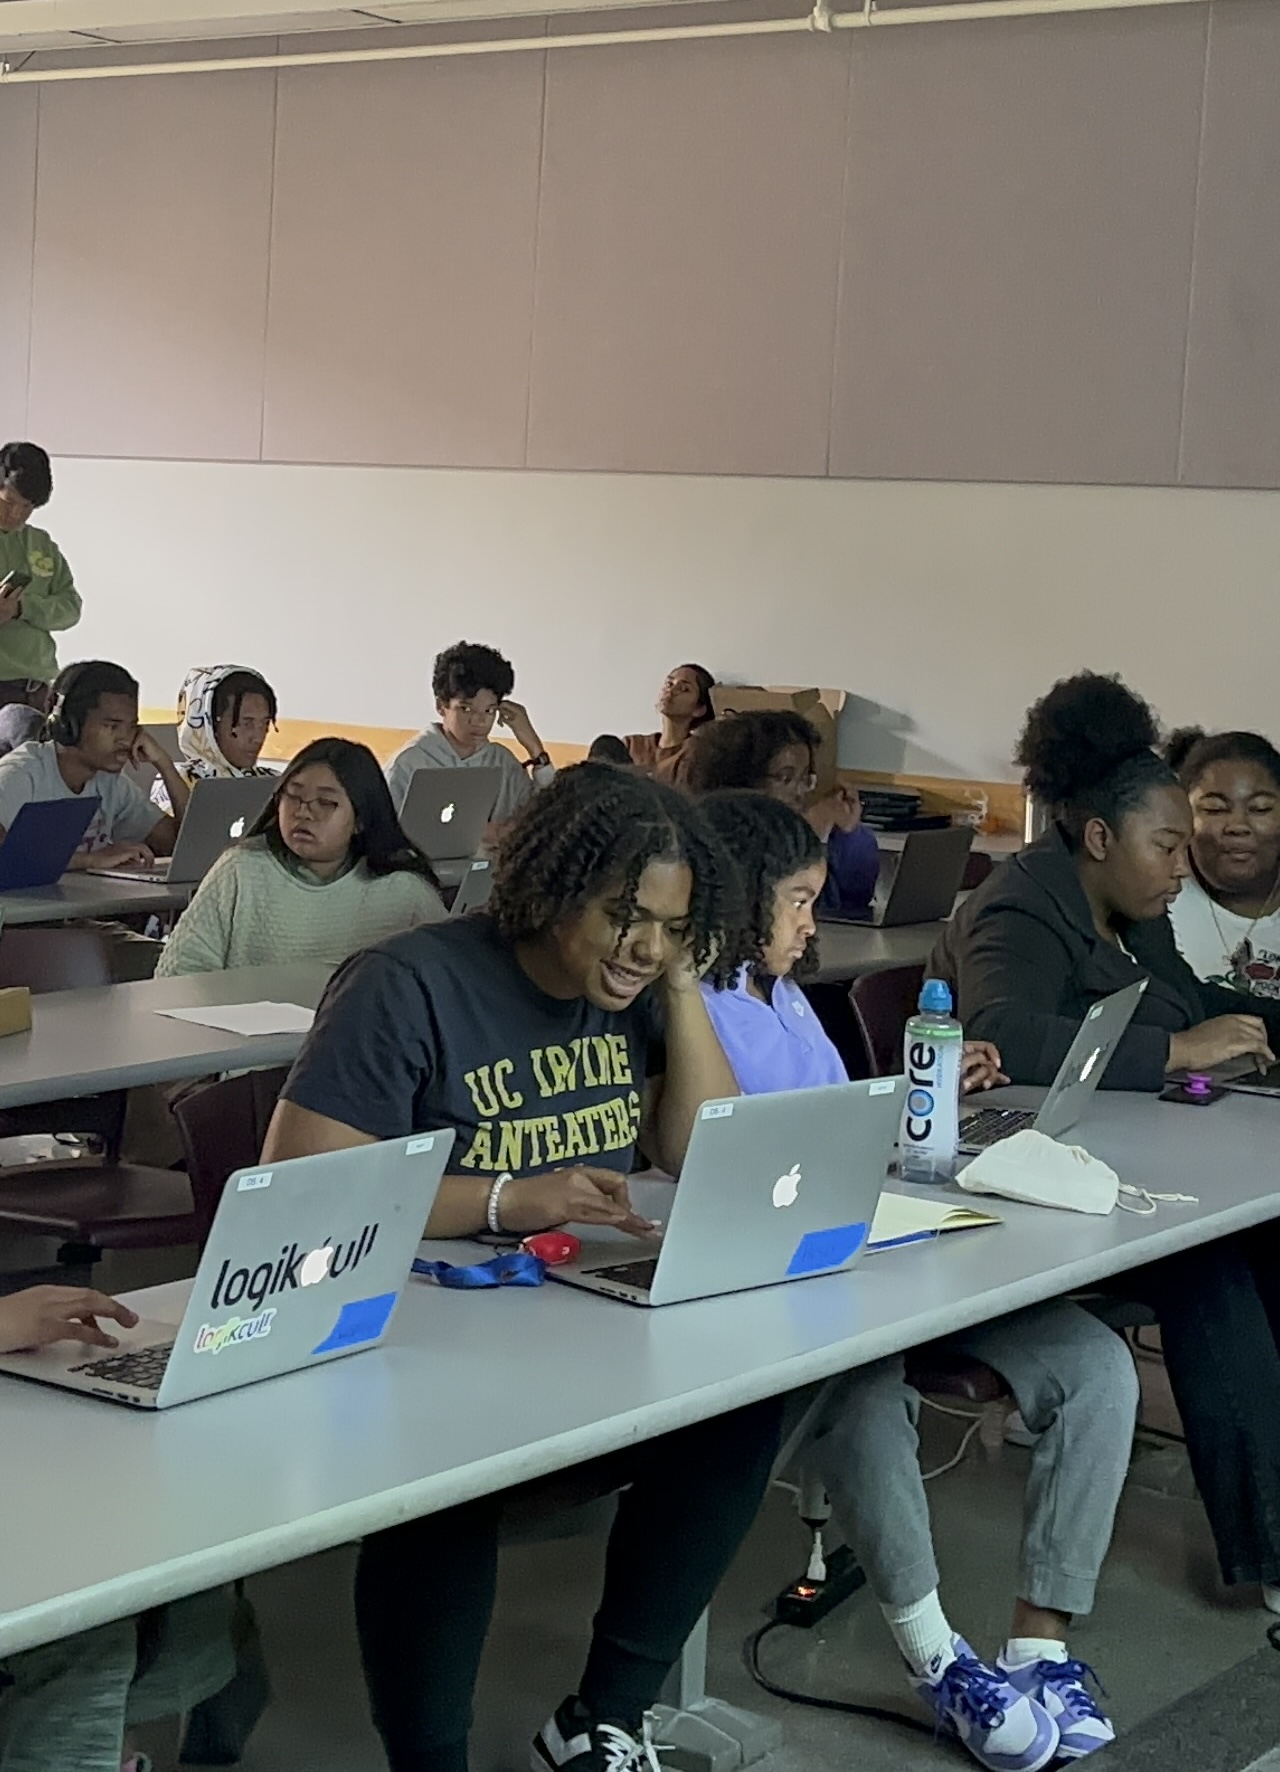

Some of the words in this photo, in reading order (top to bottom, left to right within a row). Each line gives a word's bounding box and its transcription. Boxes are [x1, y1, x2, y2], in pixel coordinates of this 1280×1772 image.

[464, 1058, 523, 1117] UC
[530, 1034, 633, 1098] IRVINE
[906, 1042, 936, 1141] core
[460, 1090, 641, 1171] ANTEATERS
[211, 1223, 380, 1311] logikull
